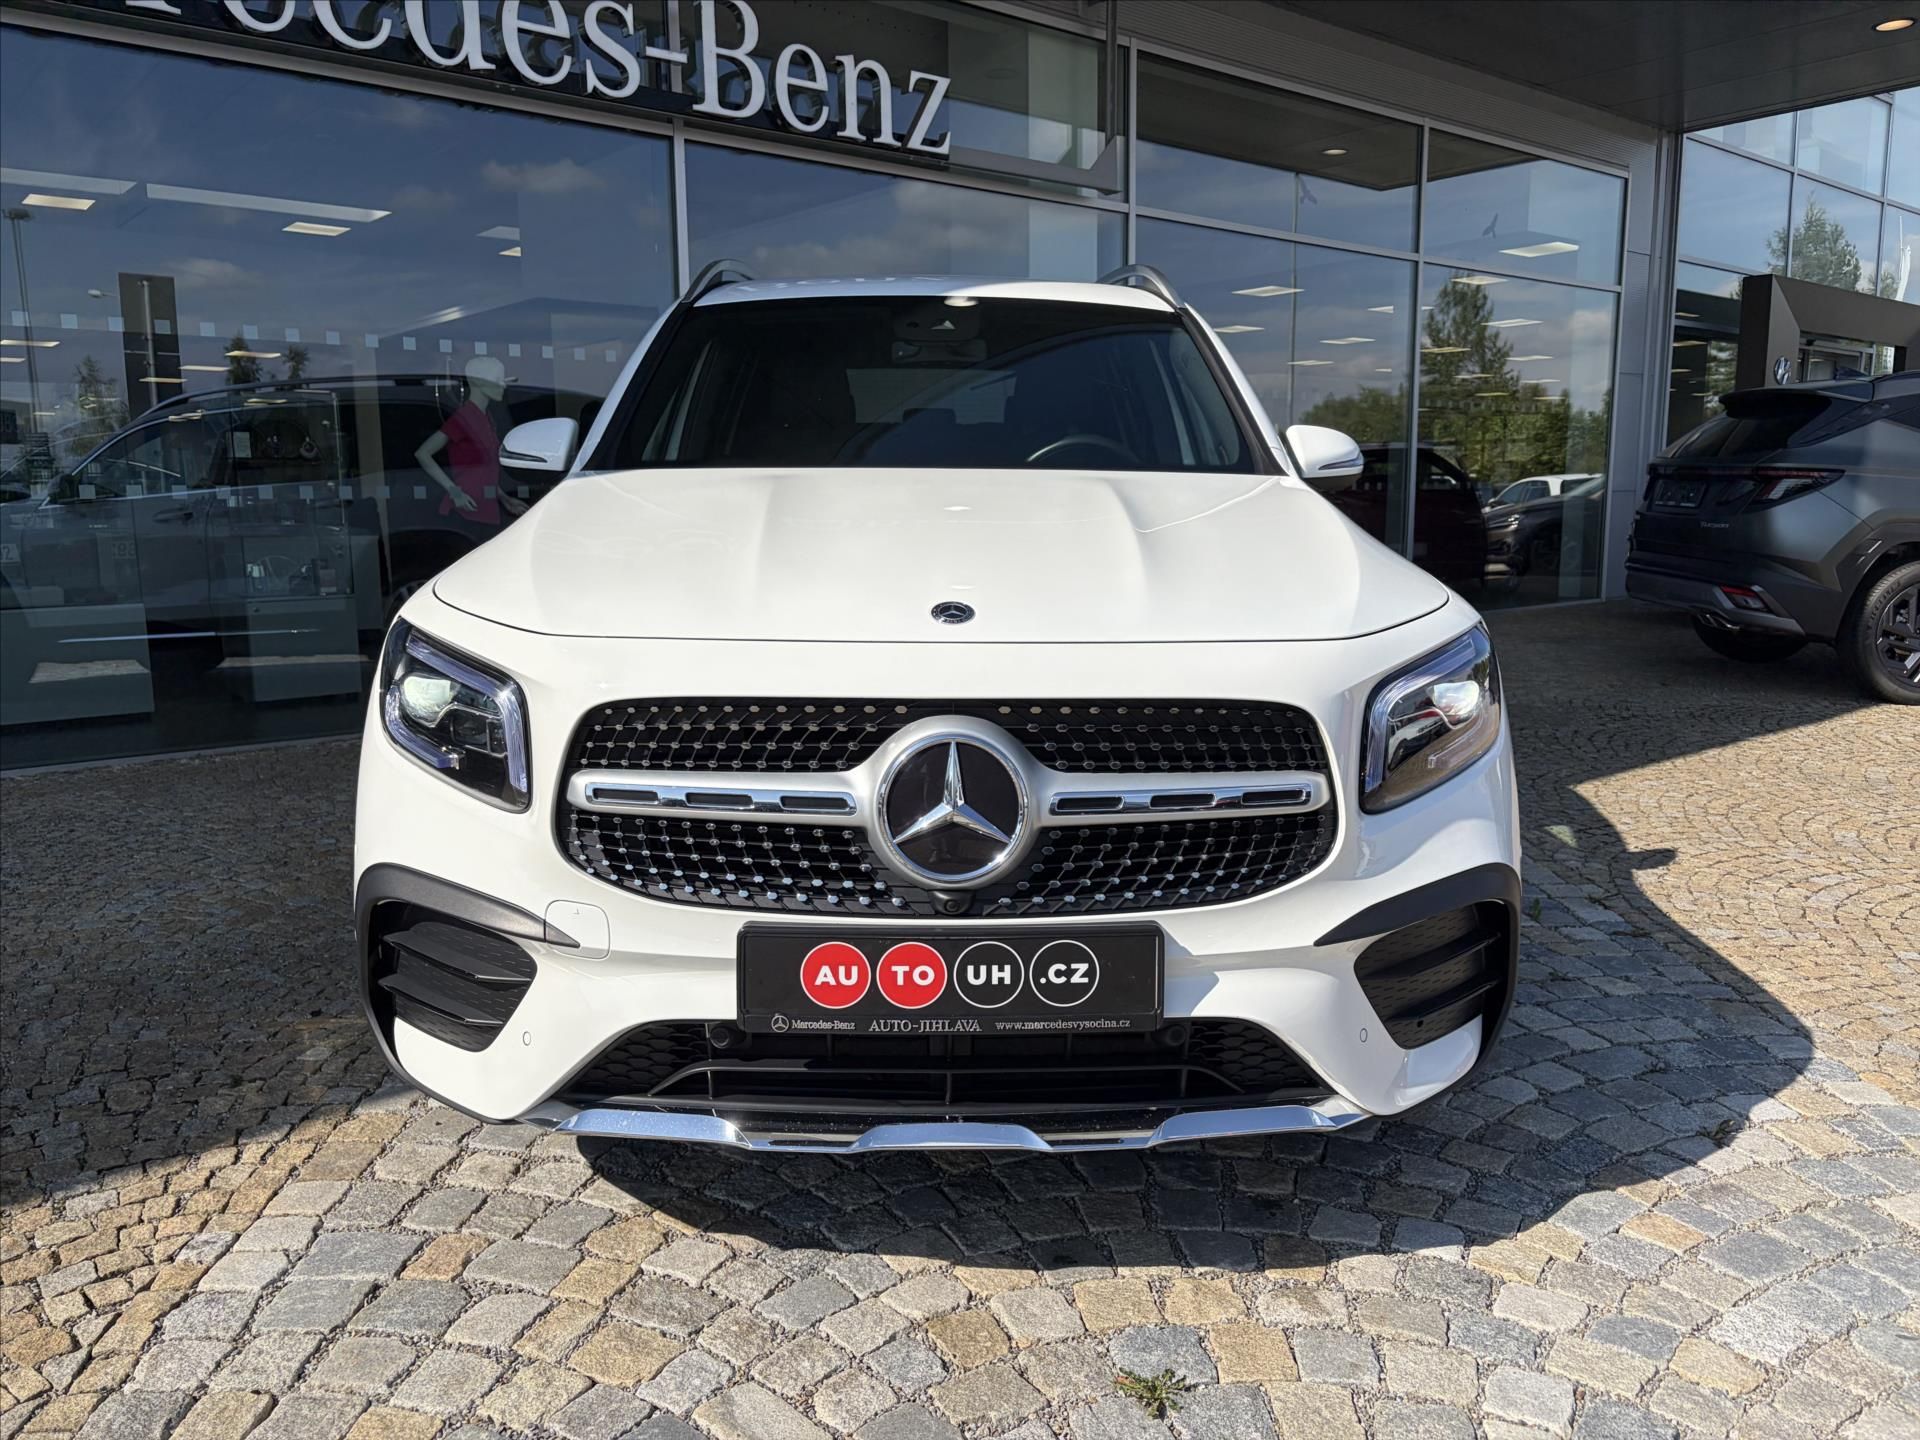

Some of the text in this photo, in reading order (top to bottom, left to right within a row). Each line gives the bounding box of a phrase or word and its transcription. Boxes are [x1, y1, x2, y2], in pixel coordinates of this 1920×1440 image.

[814, 963, 1089, 986] AU TO UH .CZ
[791, 1018, 1131, 1032] Mercedes-Benz AUTO-JIHLAVA www.mercedesvysocina.cz
